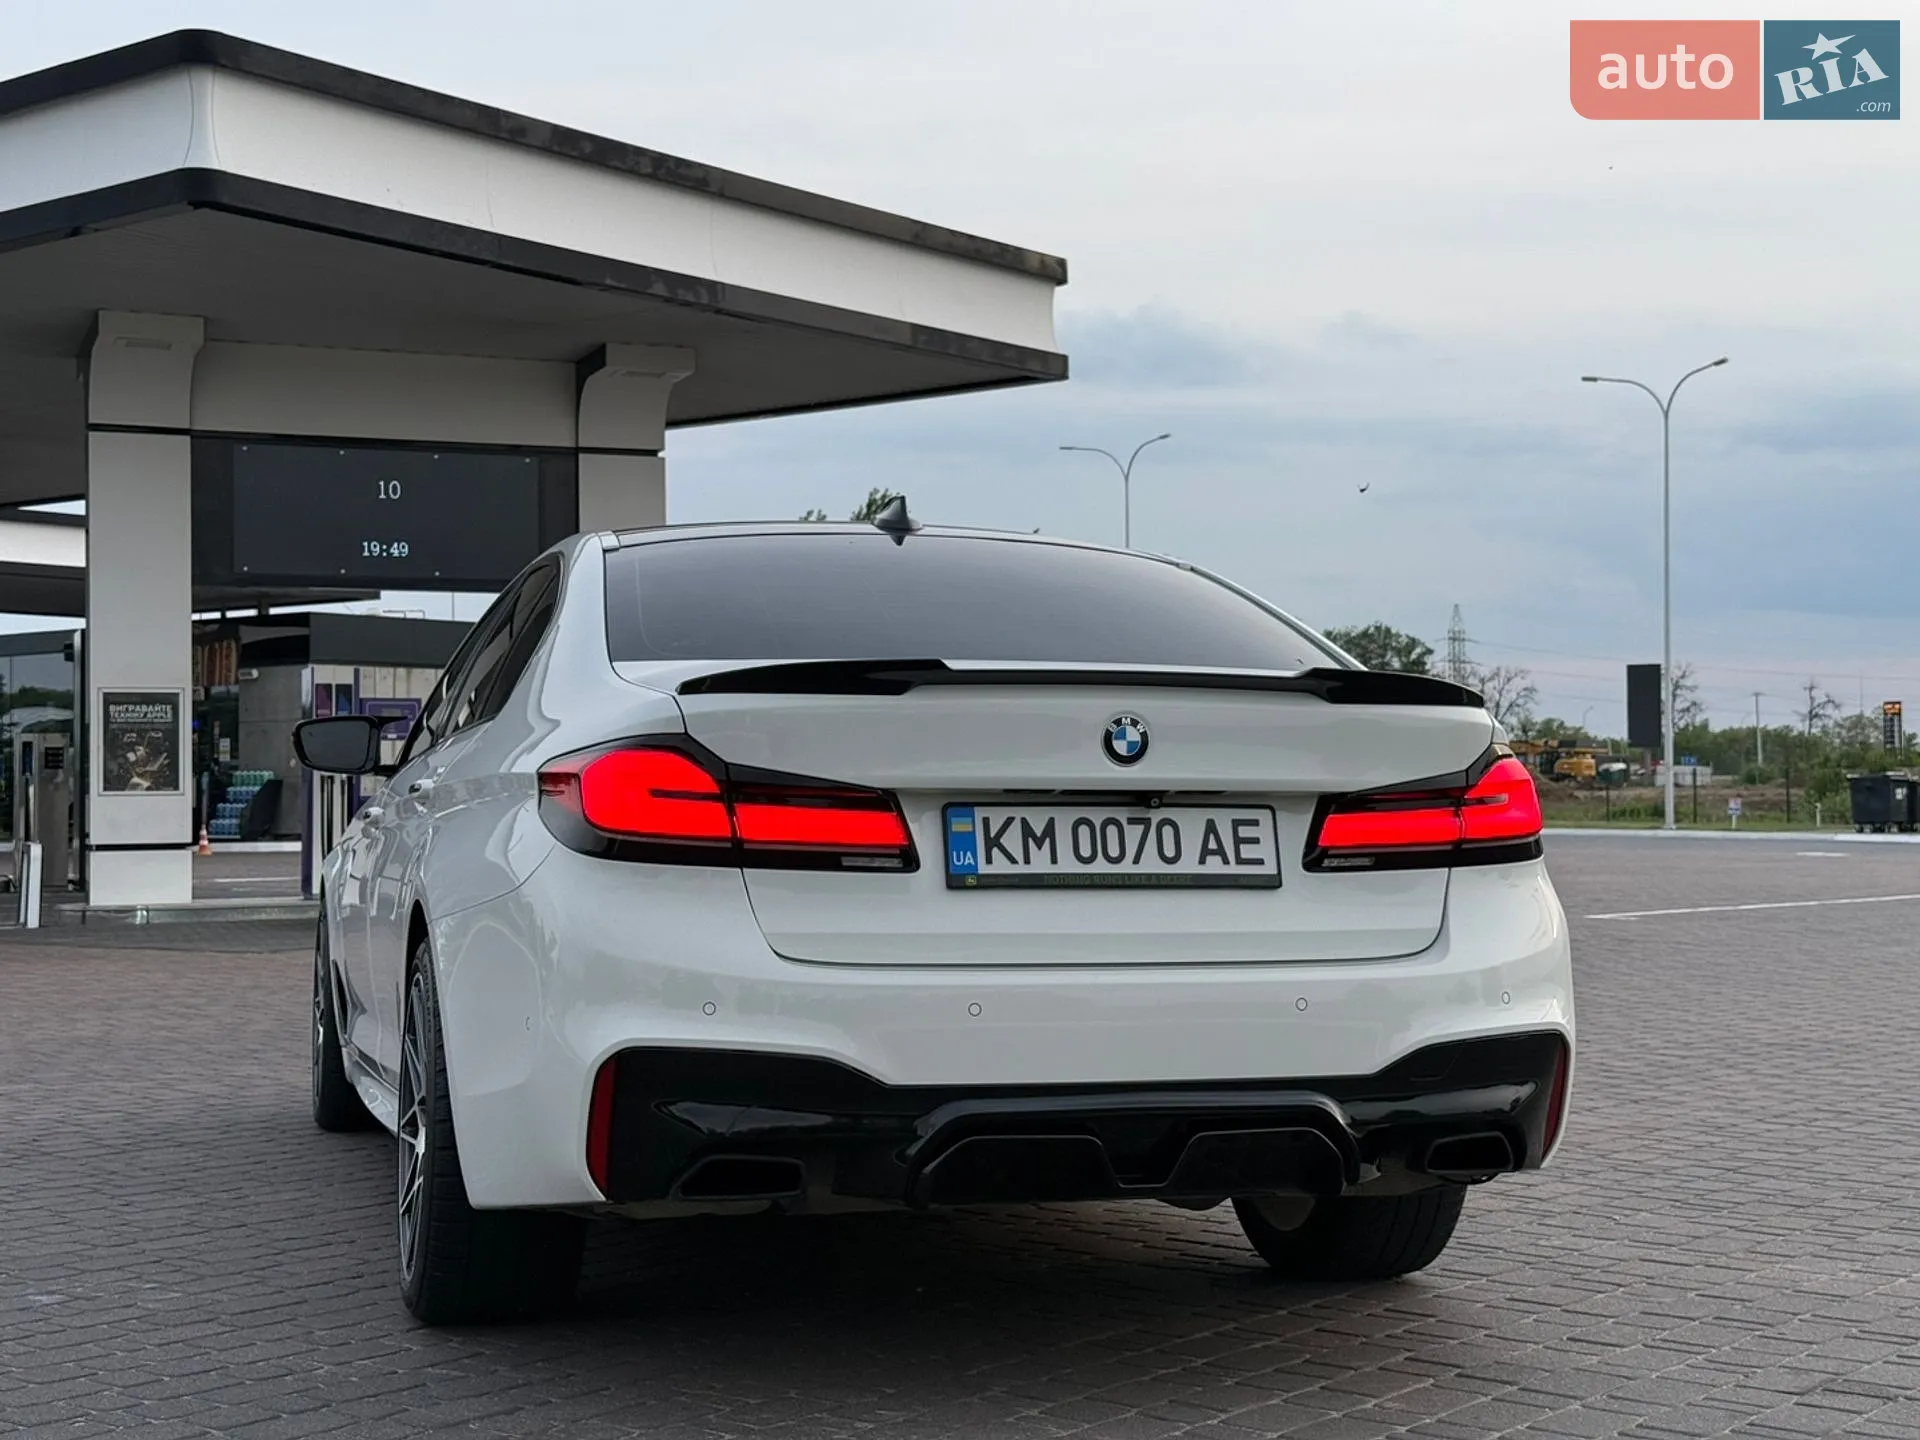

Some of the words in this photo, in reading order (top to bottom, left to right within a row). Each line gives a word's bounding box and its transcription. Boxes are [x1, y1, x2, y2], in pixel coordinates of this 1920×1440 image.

[378, 480, 401, 500] 10
[362, 541, 409, 557] 19:49
[109, 703, 173, 712] ВИГРАВАЙТЕ
[1109, 716, 1146, 733] BMW
[982, 816, 1059, 865] KM
[1071, 817, 1183, 865] 0070
[1198, 818, 1265, 865] AE
[953, 852, 975, 866] UA
